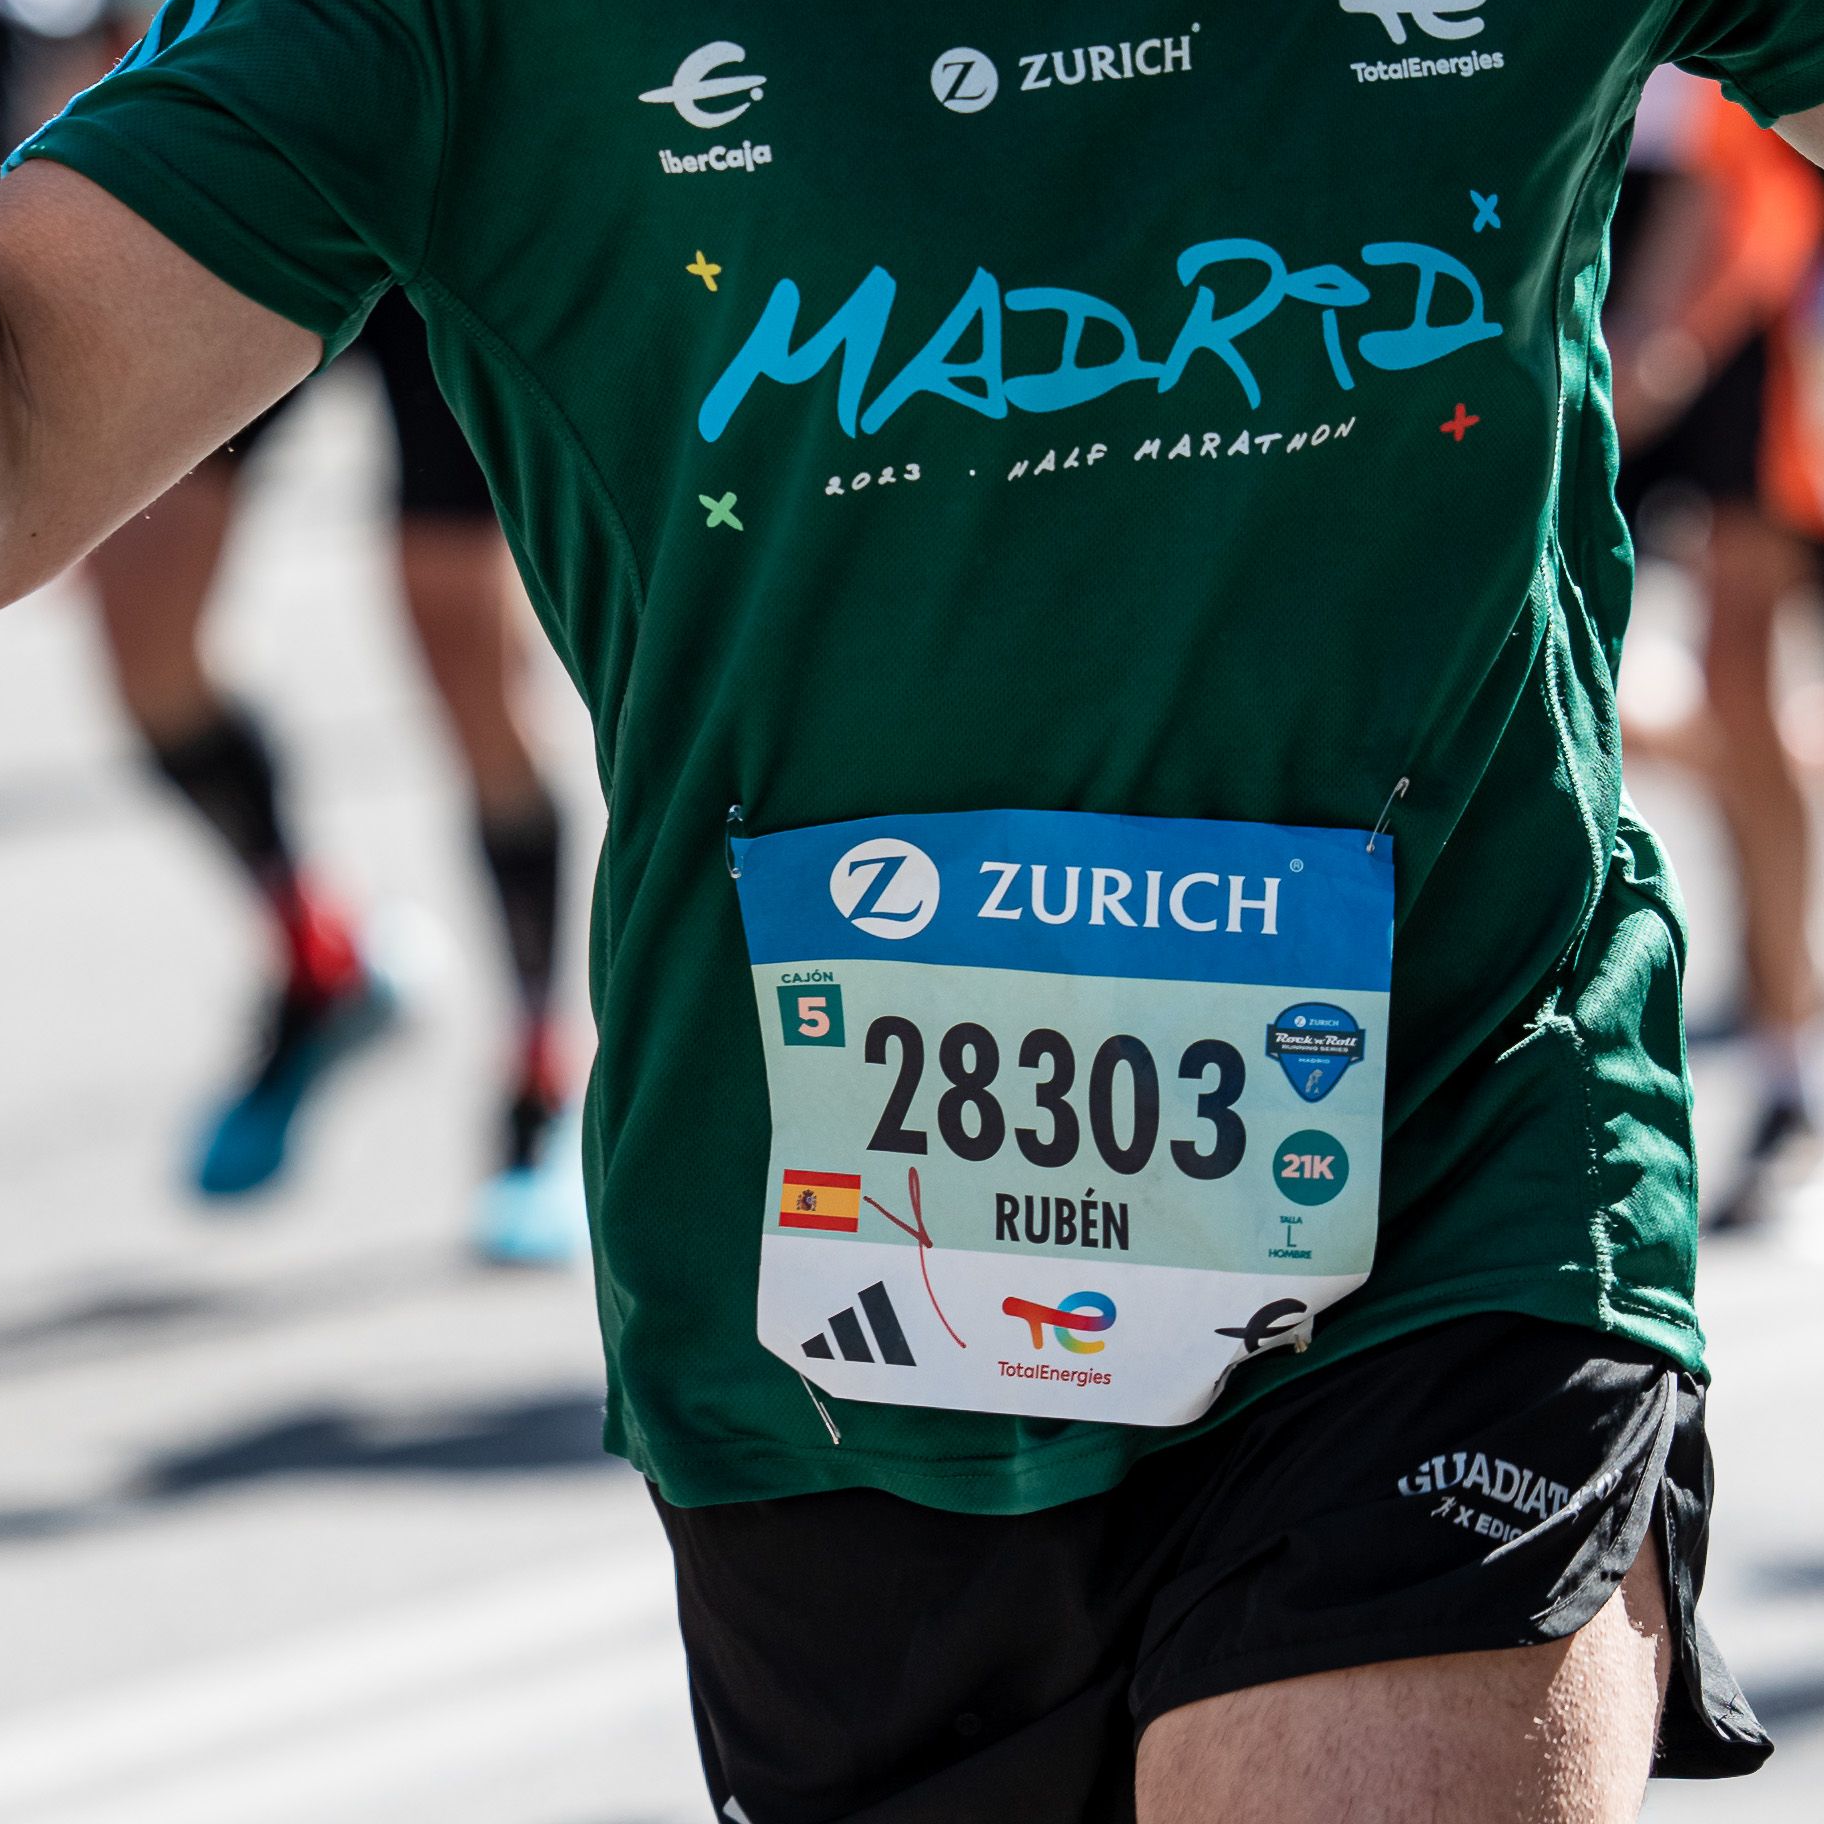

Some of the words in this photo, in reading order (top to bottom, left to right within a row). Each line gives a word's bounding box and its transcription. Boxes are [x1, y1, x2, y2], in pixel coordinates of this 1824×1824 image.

[1018, 34, 1194, 91] ZURICH
[1350, 49, 1505, 84] TotalEnergies
[1008, 442, 1108, 481] HALF
[1134, 416, 1357, 463] MARATHON
[825, 463, 923, 495] 2023
[977, 861, 1282, 936] ZURICH
[781, 969, 834, 983] CAJÓN
[797, 997, 830, 1037] 5
[1275, 1032, 1313, 1044] Rock
[1325, 1035, 1358, 1046] Roll
[863, 1015, 1247, 1181] 28303
[1281, 1153, 1335, 1180] 21K
[994, 1188, 1130, 1251] RUBÉN
[1286, 1225, 1297, 1247] L
[1268, 1249, 1312, 1259] HOMBRE
[997, 1360, 1112, 1387] TotalEnergies
